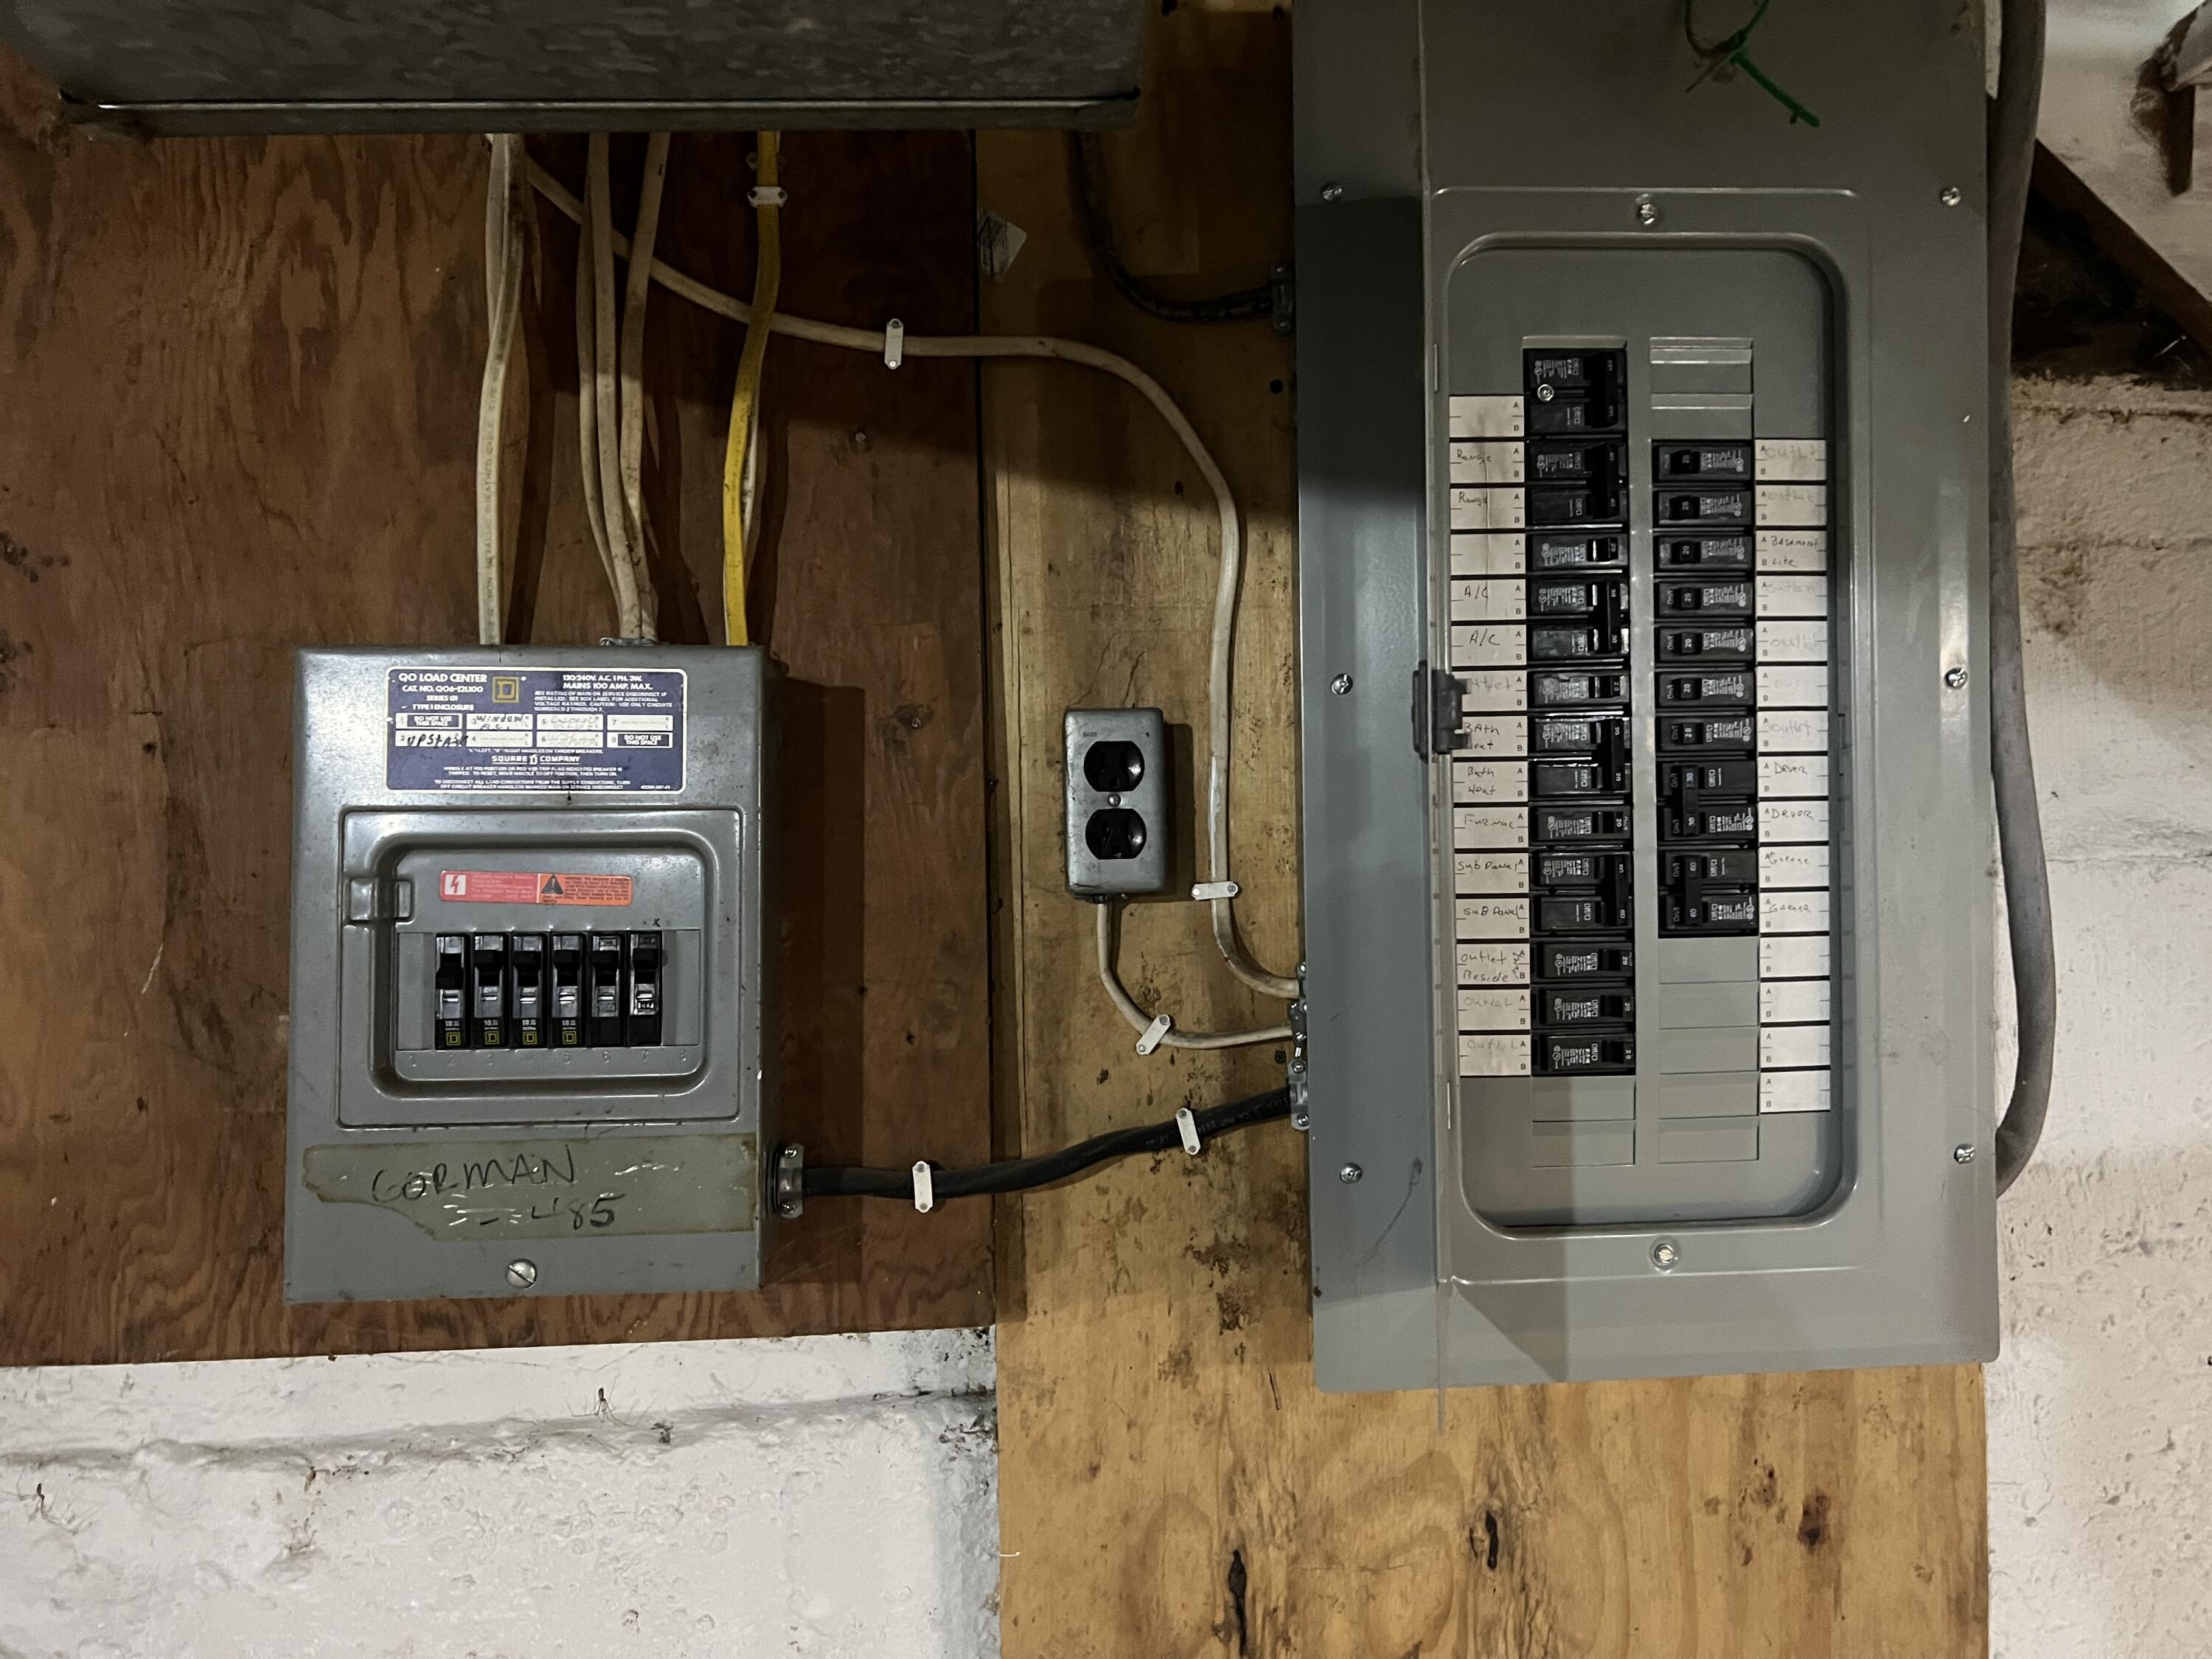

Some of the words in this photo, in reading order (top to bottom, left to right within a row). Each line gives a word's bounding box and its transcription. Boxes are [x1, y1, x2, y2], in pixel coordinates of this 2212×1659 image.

[1684, 592, 1691, 602] 20
[1469, 628, 1500, 647] A/C
[1685, 638, 1692, 649] 20
[398, 672, 417, 682] QO
[419, 673, 448, 683] LOAD
[449, 673, 487, 683] CENTER
[1472, 675, 1511, 692] utlet
[1683, 684, 1691, 693] 20
[1473, 740, 1494, 750] eat
[1689, 862, 1697, 872] 60
[1689, 908, 1697, 918] 60
[1622, 956, 1629, 966] 20
[1624, 1002, 1631, 1012] 20
[372, 1144, 576, 1203] GORMAN
